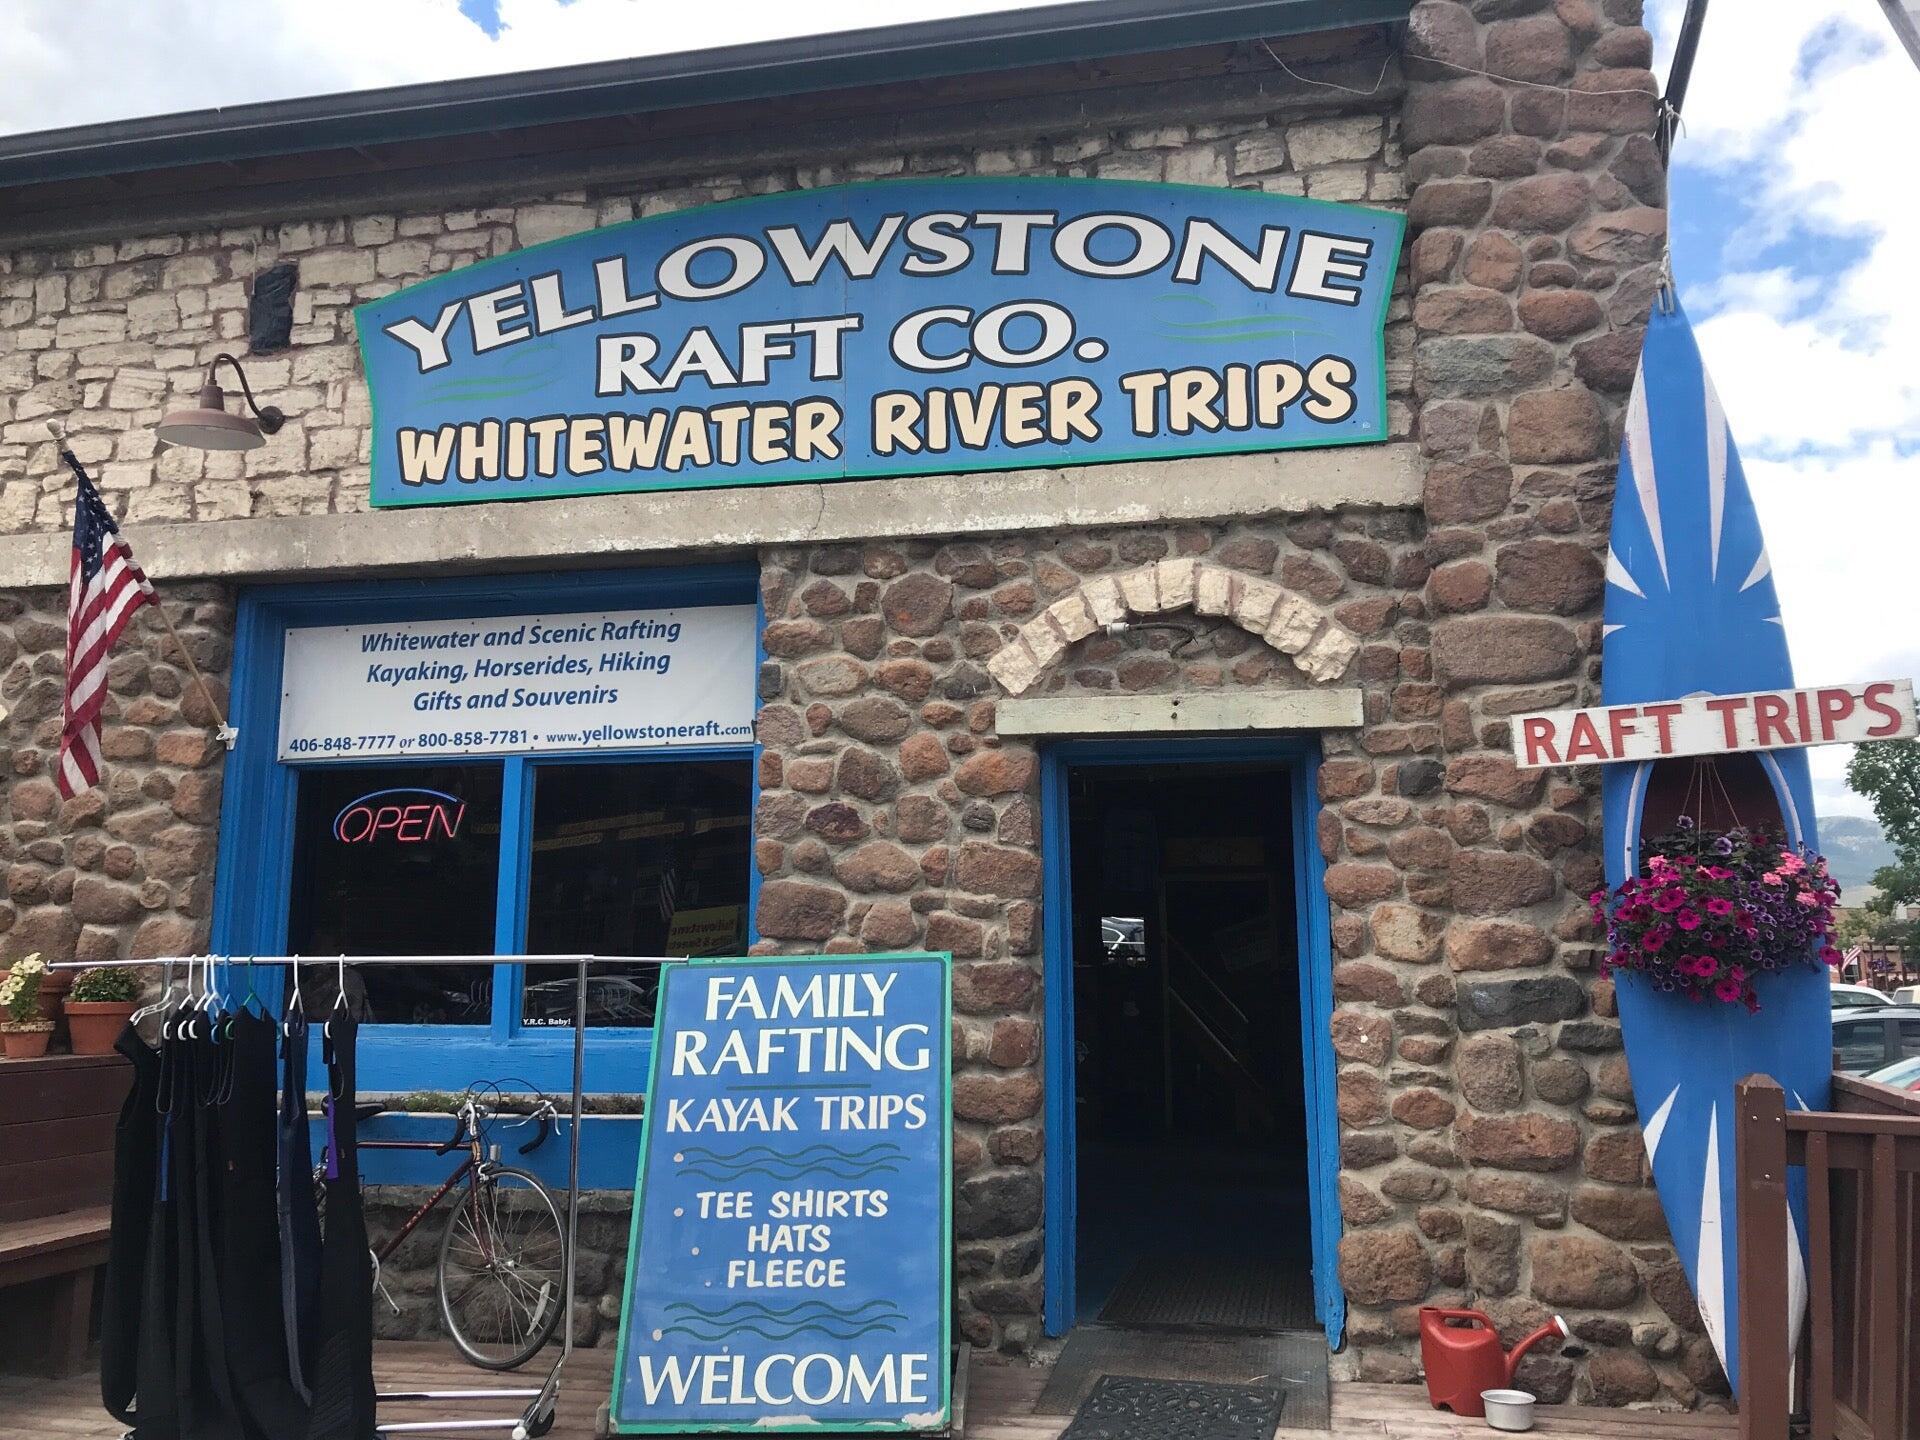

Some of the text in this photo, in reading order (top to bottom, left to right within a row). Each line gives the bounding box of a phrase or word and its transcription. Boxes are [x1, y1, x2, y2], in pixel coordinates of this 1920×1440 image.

[384, 210, 1373, 374] YELLOWSTONE
[595, 300, 1108, 397] RAFT CO.
[397, 355, 1357, 487] WHITEWATER RIVER TRIPS
[362, 620, 681, 652] Whitewater and Scenic Rafting
[367, 651, 670, 685] Kayaking, Horserides, Hiking
[414, 685, 618, 710] Gifts and Souvenirs
[290, 721, 750, 751] 406-848-7777 or 800-858-7781 www.yellowstoneraft.com
[1523, 683, 1901, 765] RAFT TRIPS
[339, 804, 465, 843] OPEN
[705, 972, 898, 1021] FAMILY
[523, 1018, 571, 1026] Y.R.C. Baby!
[672, 1024, 930, 1076] RAFTING
[666, 1094, 927, 1133] KAYAK TRIPS
[697, 1190, 889, 1219] TEE SHIRTS
[747, 1224, 831, 1253] HATS
[727, 1259, 846, 1288] FLEECE
[638, 1353, 928, 1405] WELCOME
